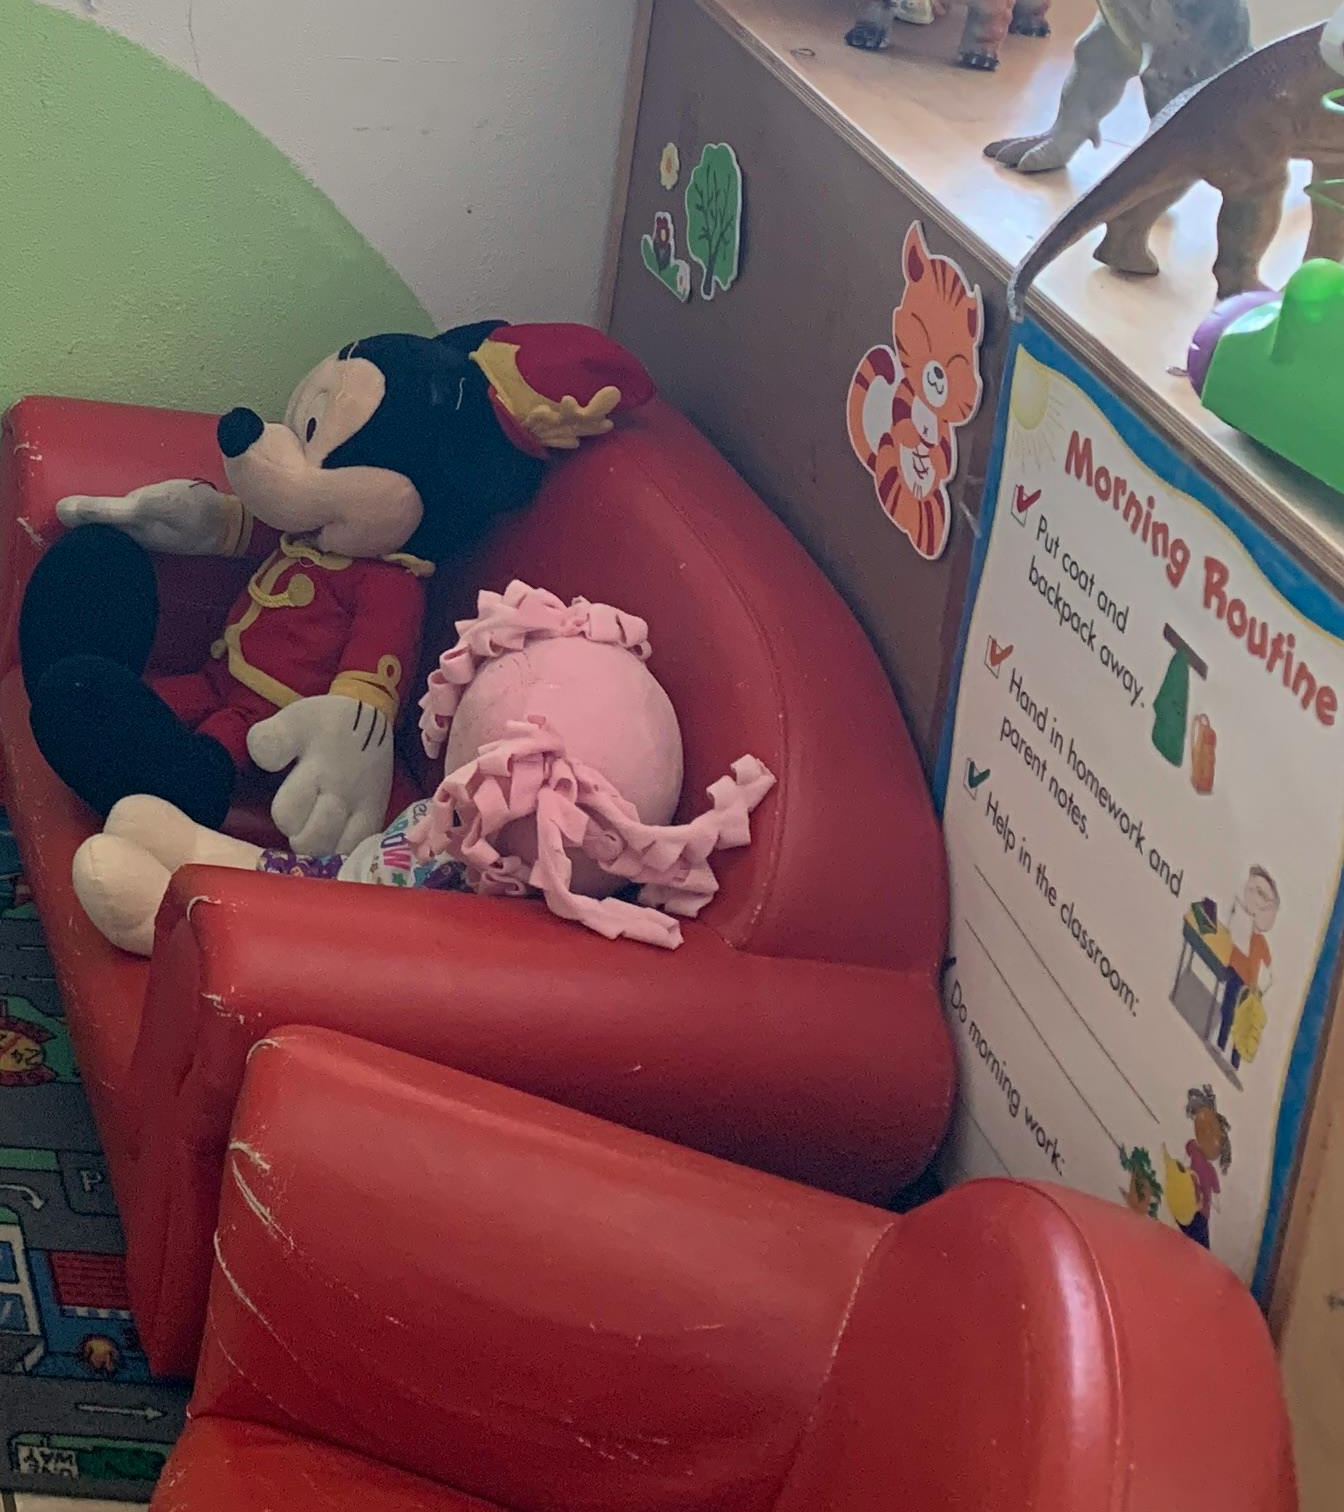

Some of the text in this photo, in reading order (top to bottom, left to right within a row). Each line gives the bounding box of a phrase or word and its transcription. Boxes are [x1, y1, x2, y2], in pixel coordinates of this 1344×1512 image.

[1028, 555, 1145, 709] backpack away.
[1037, 514, 1129, 634] Put coat and
[1065, 430, 1338, 727] Morning Routine
[1000, 715, 1091, 841] parent notes.
[1008, 667, 1185, 899] Hand in homework and
[985, 791, 1140, 1018] Help in the classroom:
[950, 978, 1065, 1177] Do morning work:
